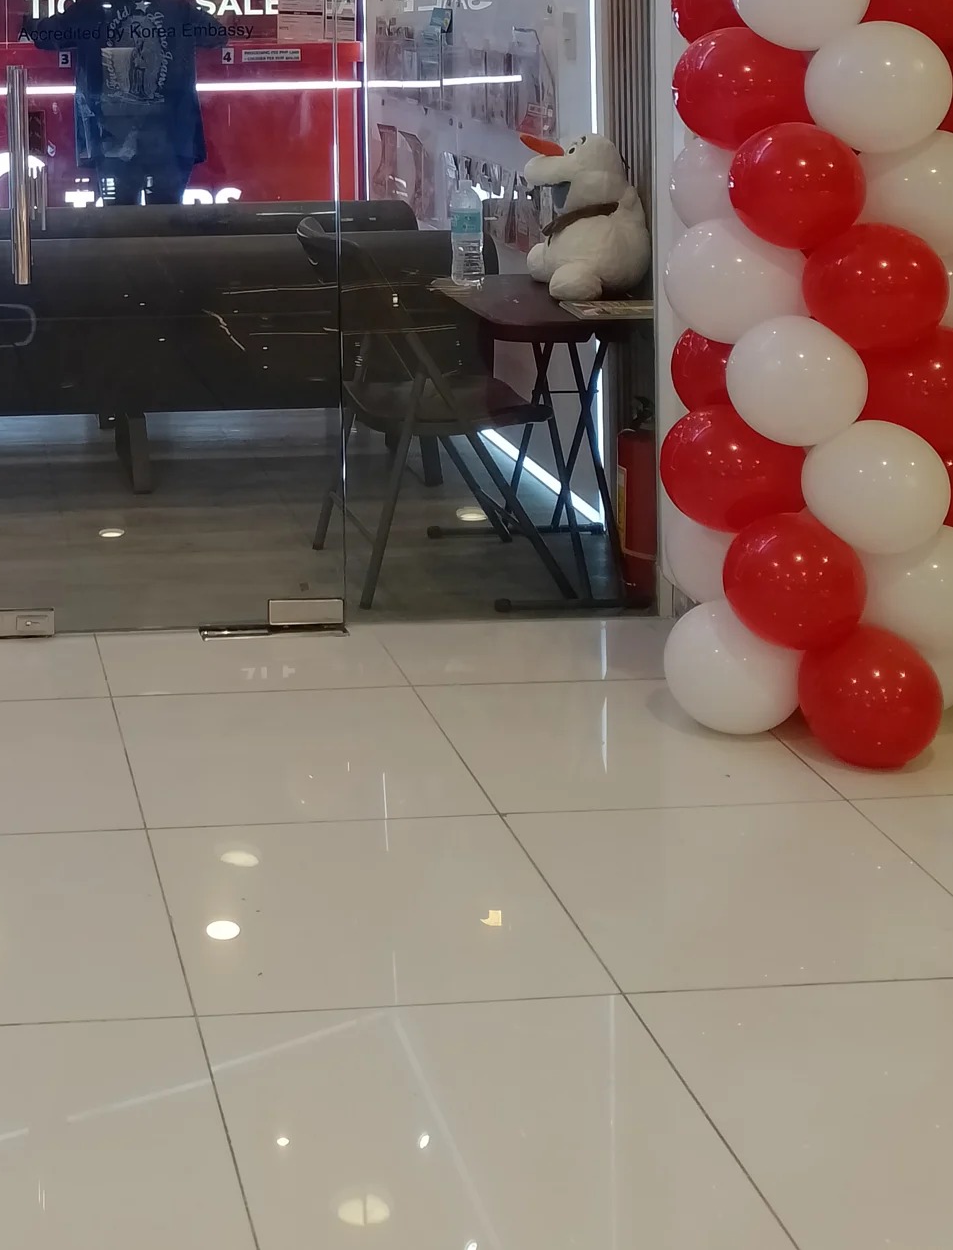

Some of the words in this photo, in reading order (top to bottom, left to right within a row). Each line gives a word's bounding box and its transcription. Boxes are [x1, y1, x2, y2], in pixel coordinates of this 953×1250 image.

[17, 26, 101, 42] Accredited
[106, 25, 125, 43] by
[130, 23, 176, 39] Korea
[182, 22, 254, 39] Embassy
[60, 53, 69, 65] 3
[222, 51, 232, 63] 4
